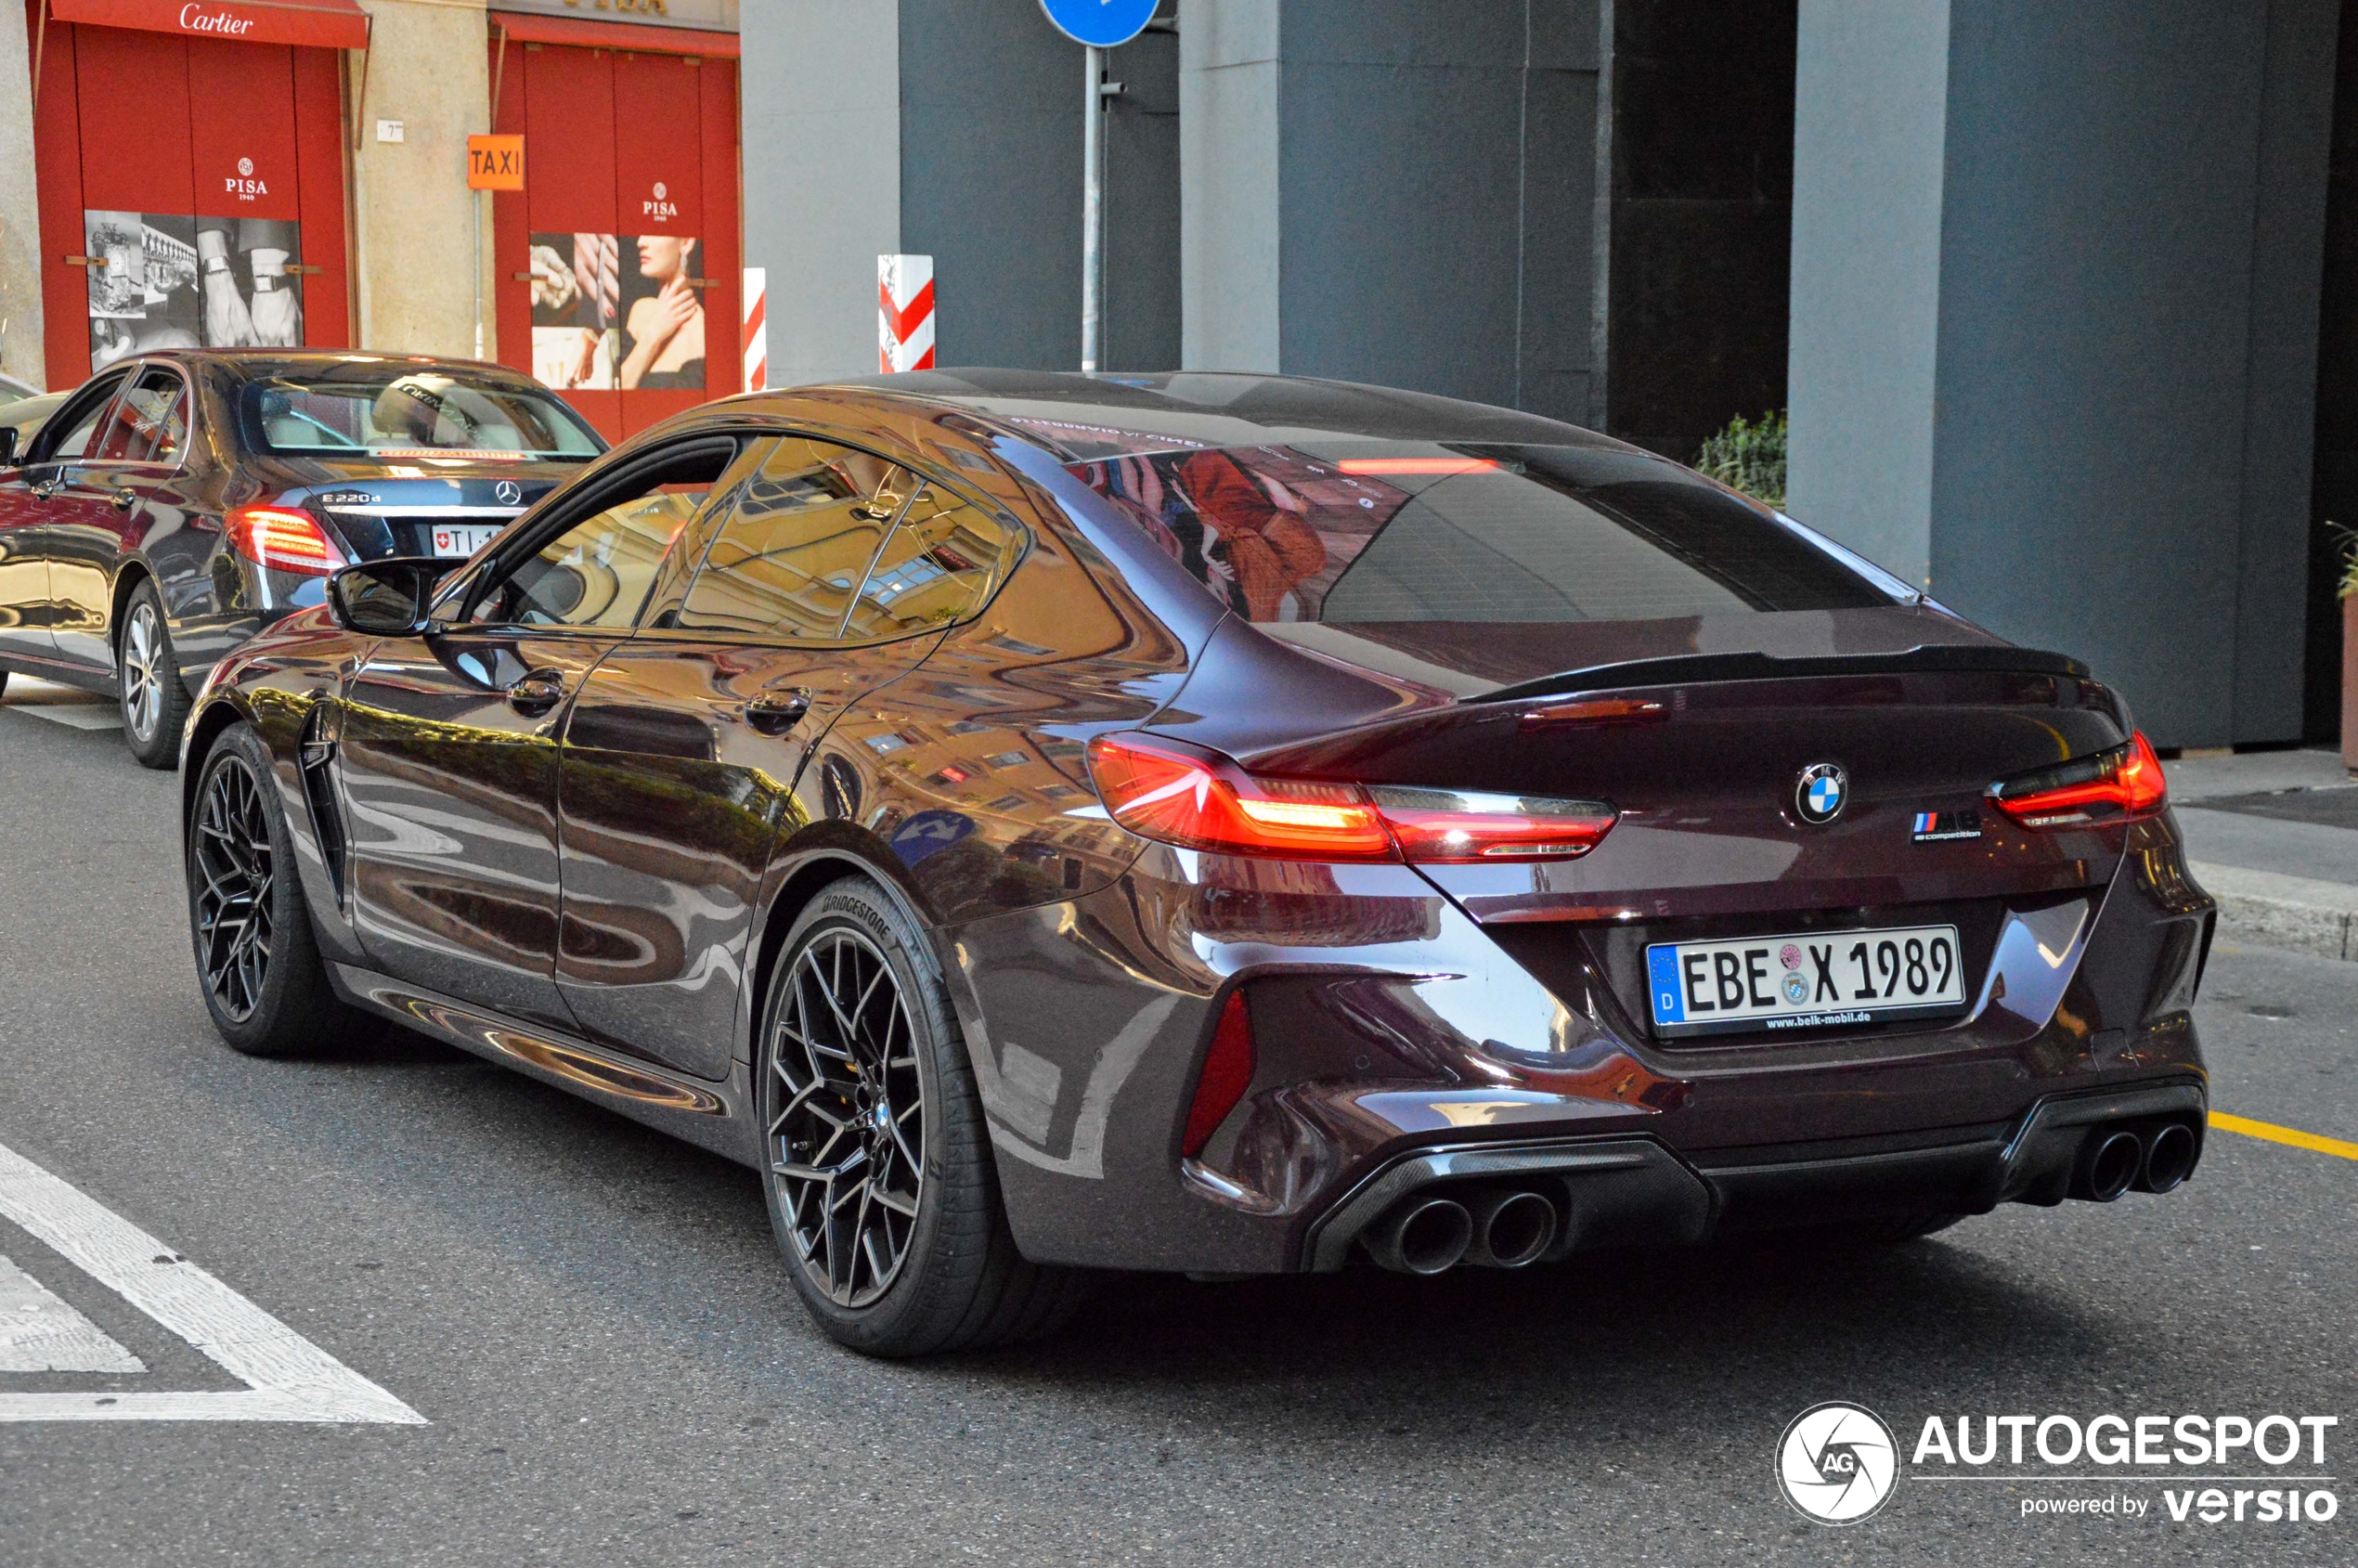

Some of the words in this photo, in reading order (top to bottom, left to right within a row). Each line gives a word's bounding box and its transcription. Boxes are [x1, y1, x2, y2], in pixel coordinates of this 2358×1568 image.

[179, 3, 253, 34] Cartier
[472, 150, 519, 174] TAXI
[225, 178, 268, 194] PISA
[642, 201, 678, 215] PISA
[322, 494, 334, 502] E
[1805, 766, 1846, 787] BMW
[1924, 830, 1981, 841] competition
[822, 895, 891, 940] BRIDGESTONE
[1662, 992, 1674, 1011] D
[1683, 949, 1776, 1013] EBE
[1808, 944, 1840, 1003] X
[1849, 937, 1953, 1000] 1989
[1767, 1012, 1872, 1029] www.belk-mobil.de
